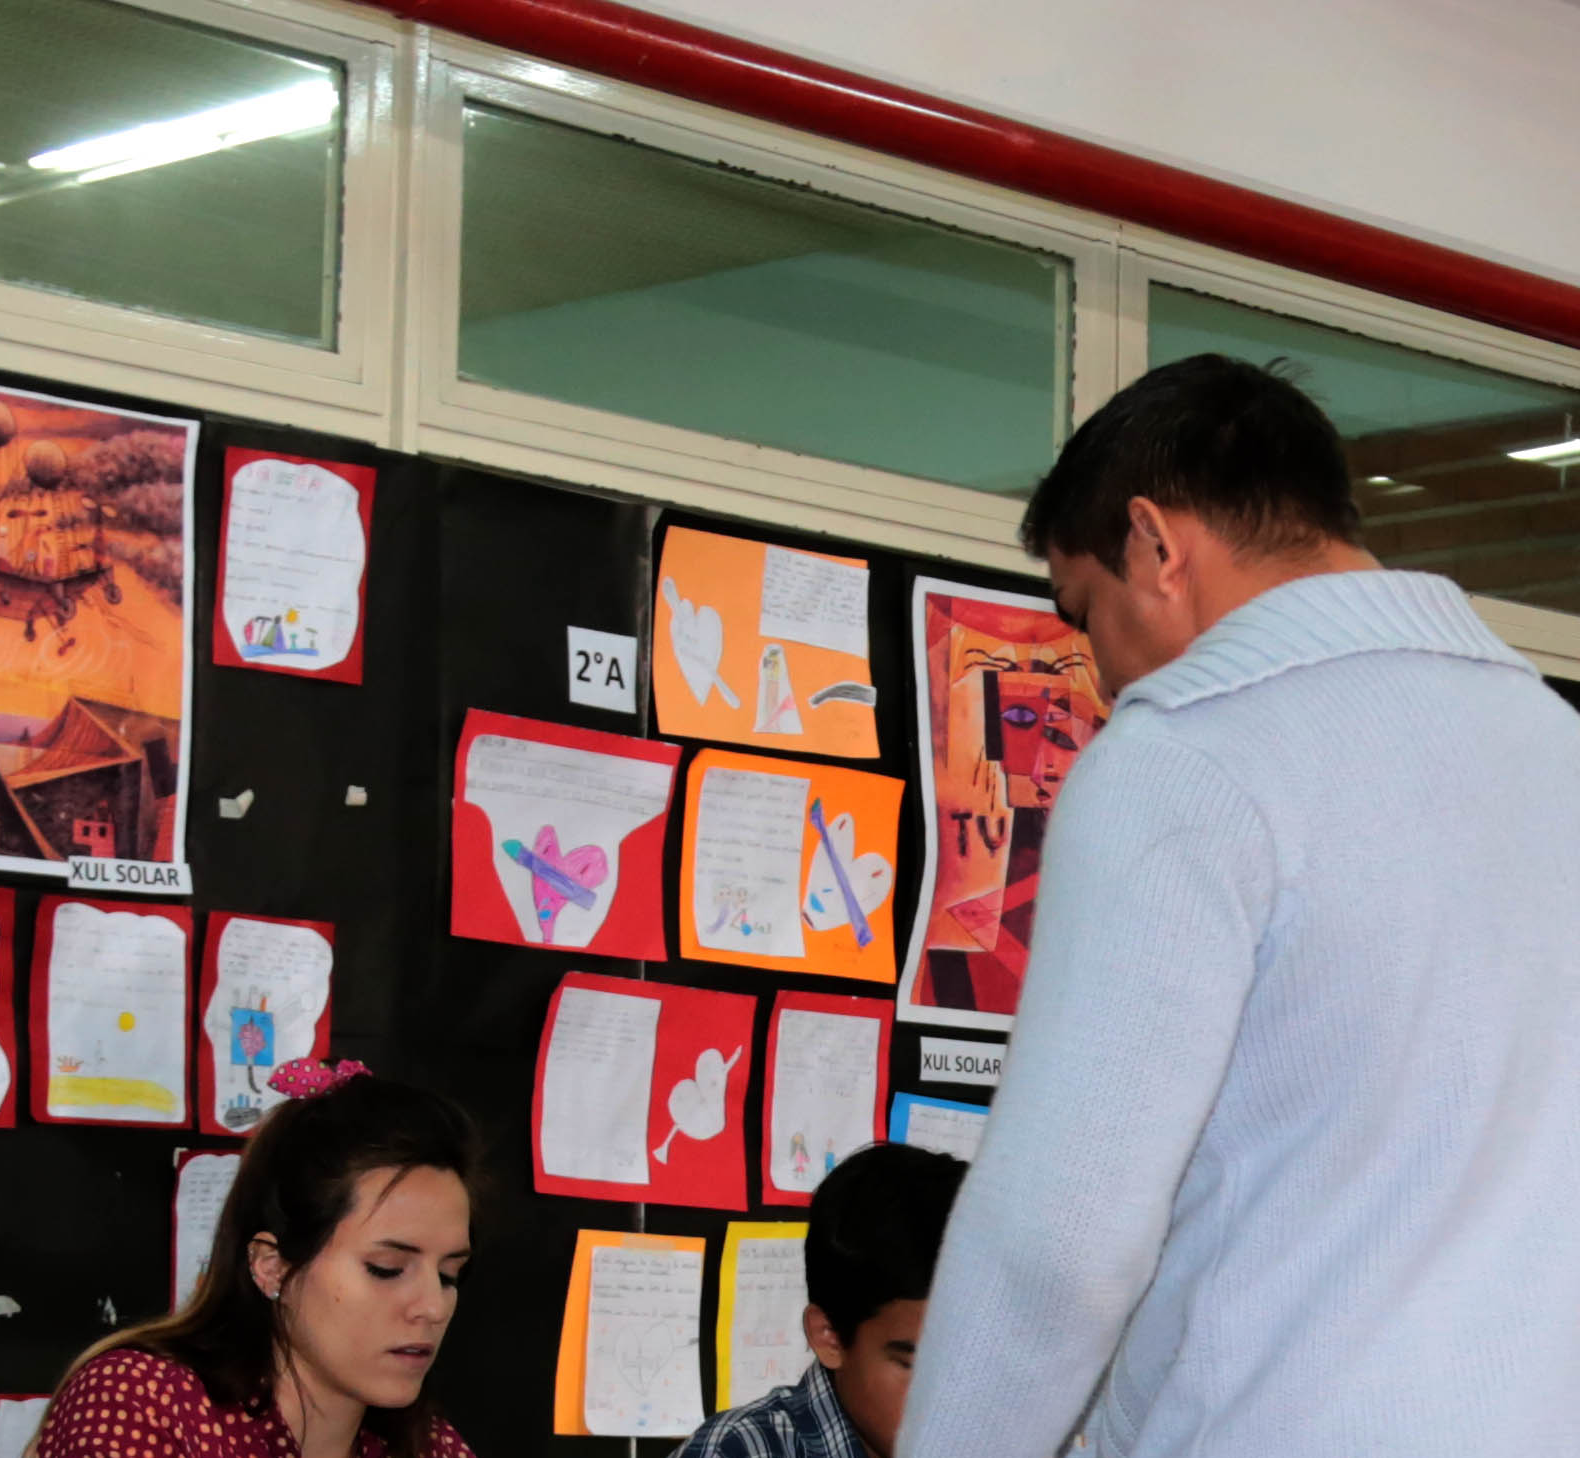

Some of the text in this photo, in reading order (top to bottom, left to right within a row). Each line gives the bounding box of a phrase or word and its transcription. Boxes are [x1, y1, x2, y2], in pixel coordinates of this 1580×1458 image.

[72, 861, 180, 886] XUL SOLAR
[924, 1053, 1002, 1075] XUL SOLAR
